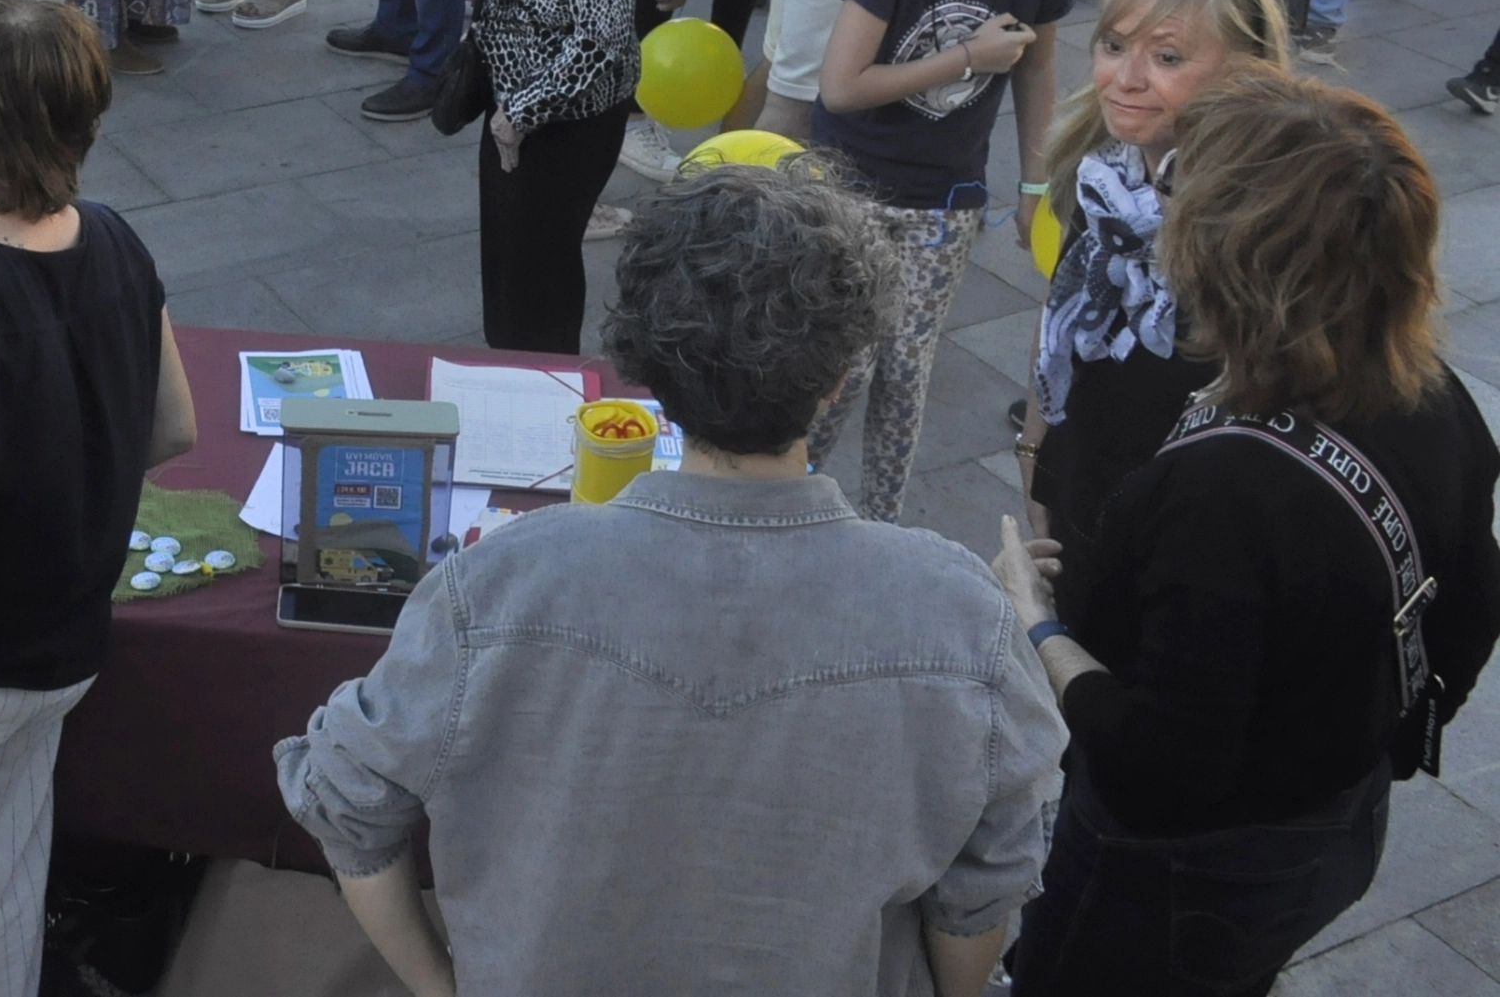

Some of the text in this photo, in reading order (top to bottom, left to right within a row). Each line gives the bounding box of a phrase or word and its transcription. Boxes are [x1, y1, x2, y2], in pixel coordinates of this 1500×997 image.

[344, 461, 395, 477] JACA
[346, 452, 362, 460] UVI
[1309, 434, 1371, 493] CUPLÉ
[1371, 496, 1406, 551] CUPLÉ
[1425, 712, 1436, 738] LOVE
